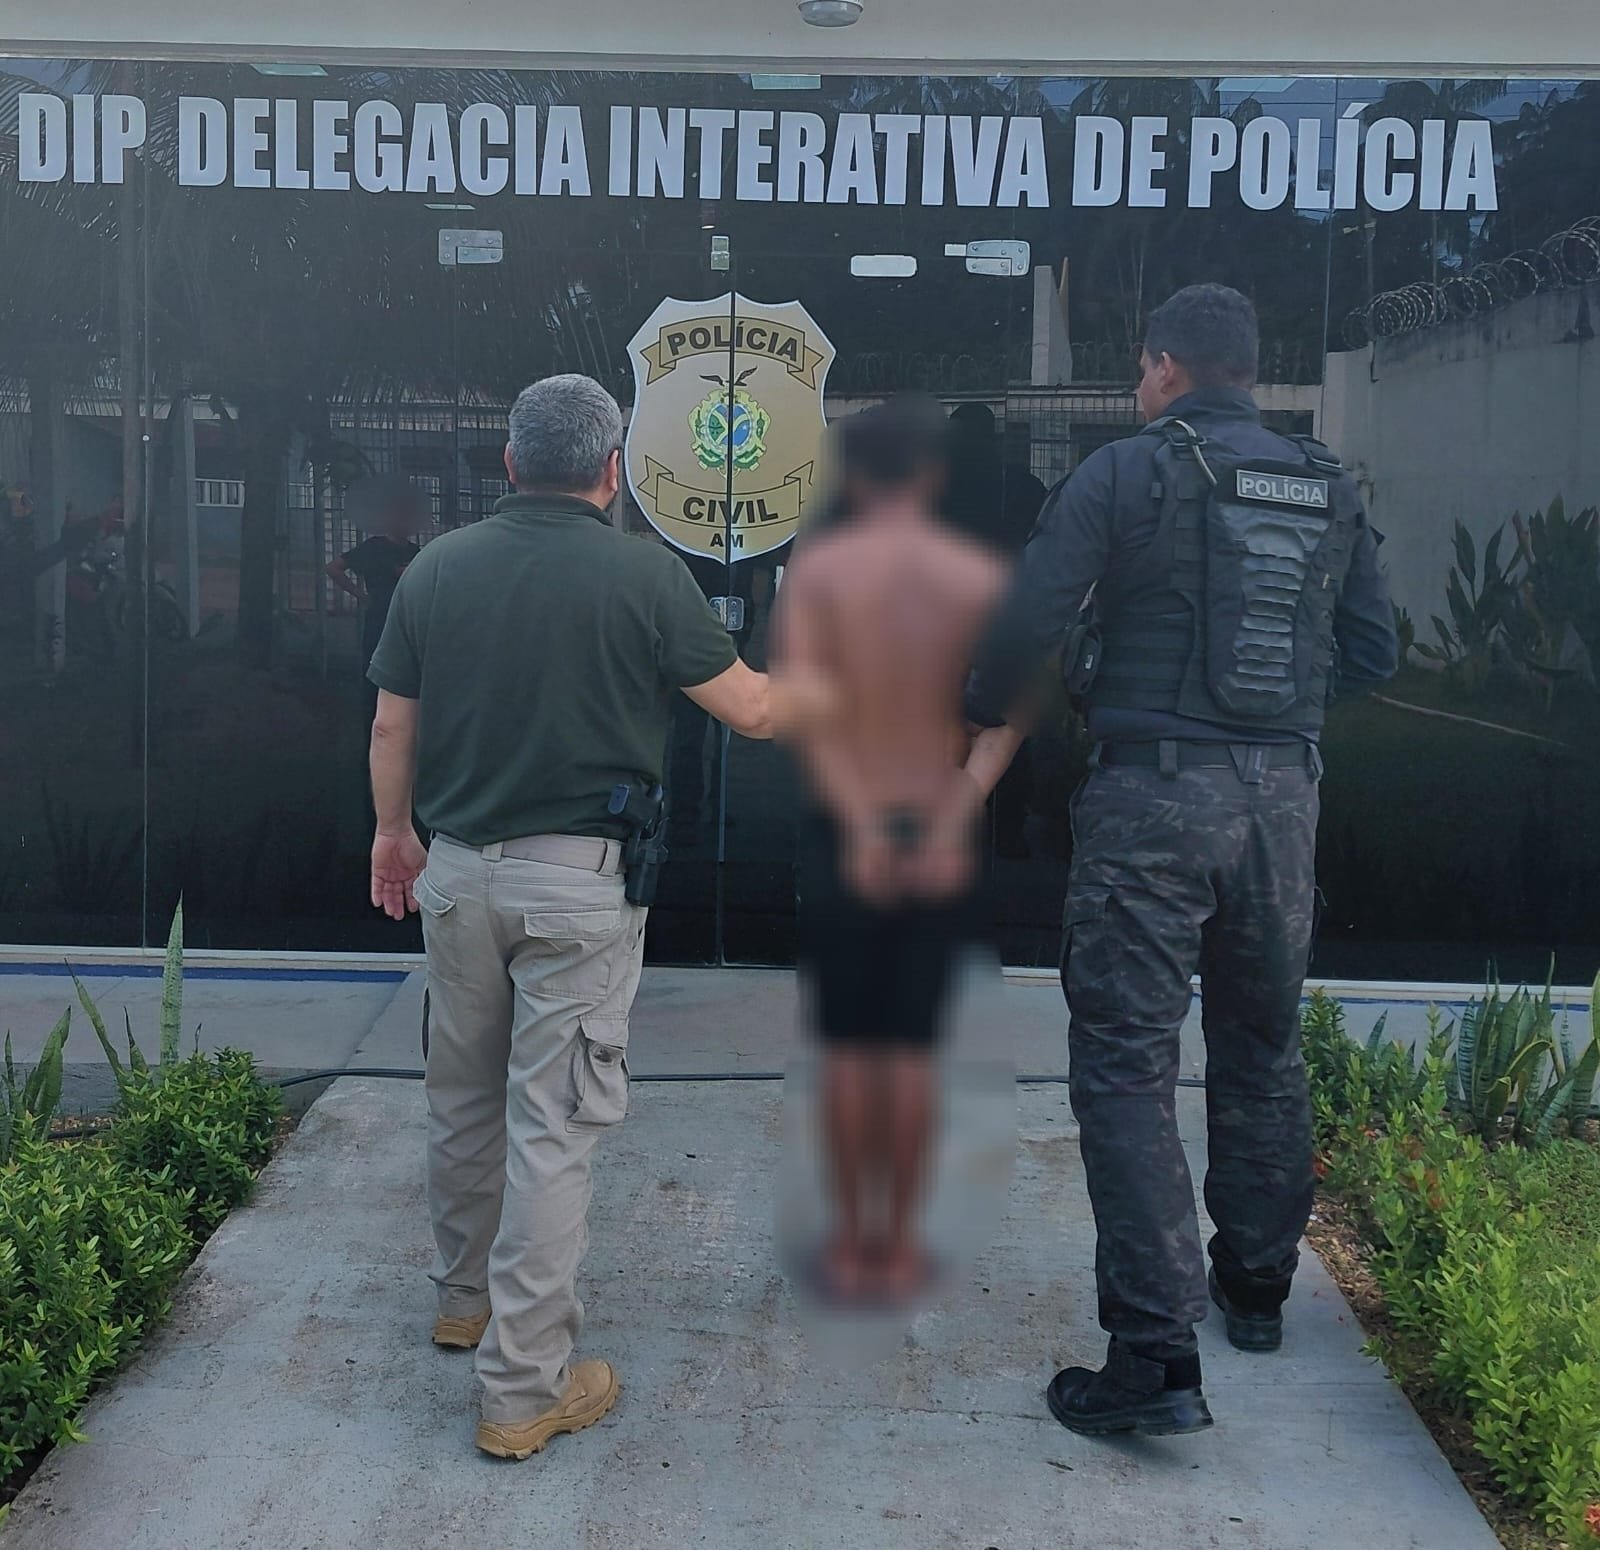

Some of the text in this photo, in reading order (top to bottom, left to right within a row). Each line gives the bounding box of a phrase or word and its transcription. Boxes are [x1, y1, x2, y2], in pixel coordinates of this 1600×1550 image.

[18, 93, 1499, 212] DIP DELEGACIA INTERATIVA DE POLÍCIA
[667, 321, 798, 361] POLÍCIA
[1242, 478, 1324, 504] POLÍCIA
[683, 497, 778, 524] CIVIL
[710, 533, 744, 548] AM
